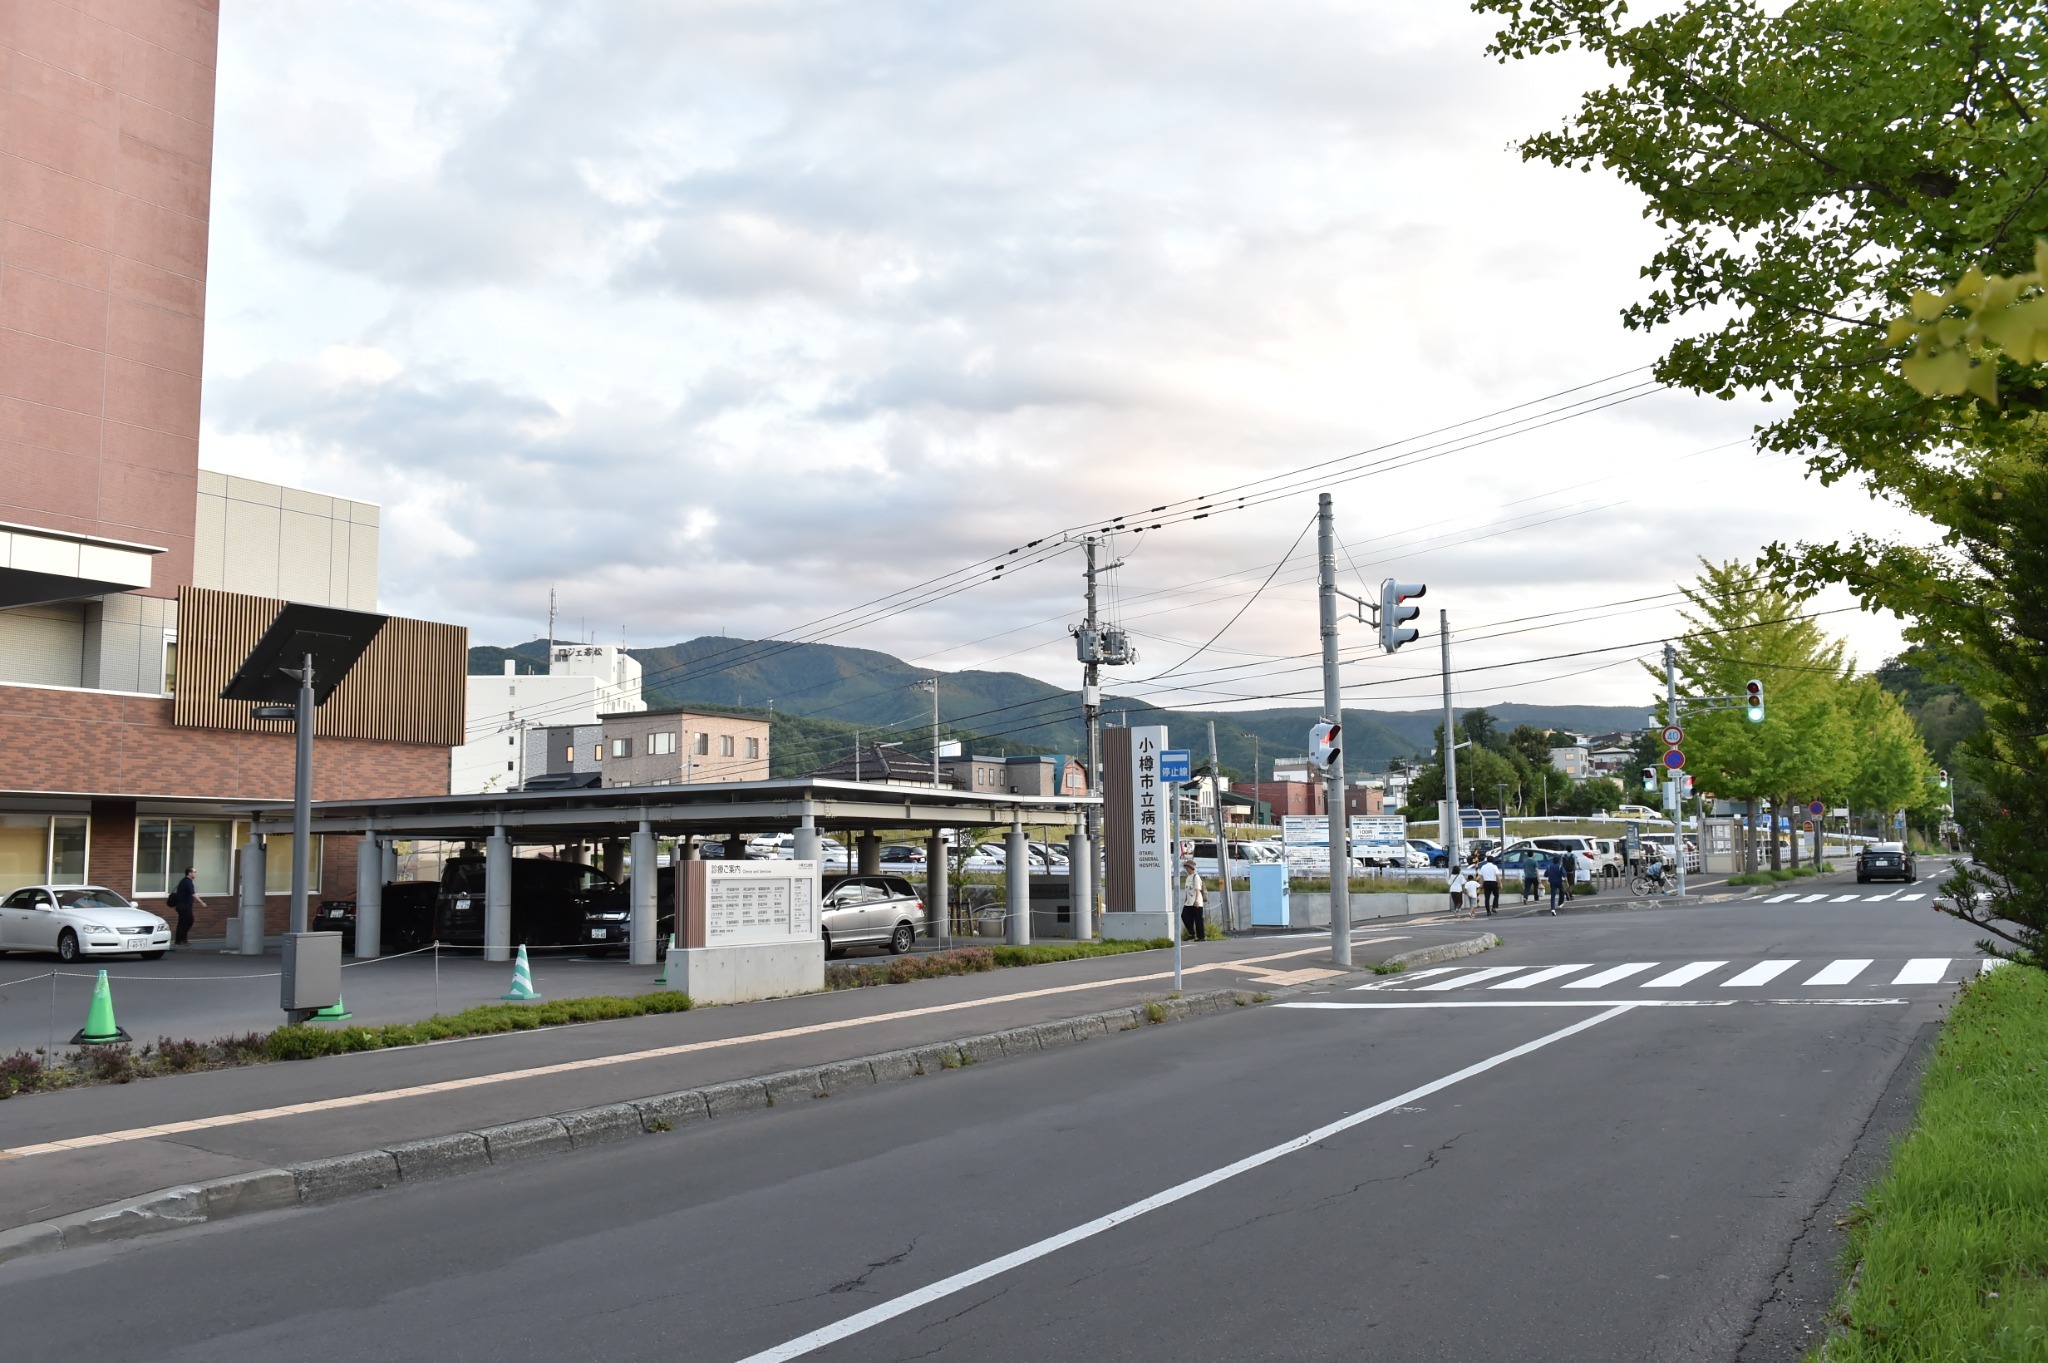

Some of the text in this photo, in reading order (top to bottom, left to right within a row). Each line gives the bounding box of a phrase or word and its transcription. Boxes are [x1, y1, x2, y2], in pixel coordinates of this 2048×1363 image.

[1667, 731, 1678, 740] 40
[1162, 767, 1188, 777] 停止線
[1139, 737, 1156, 844] 小樽市立病院
[711, 864, 741, 874] 診療ご案内
